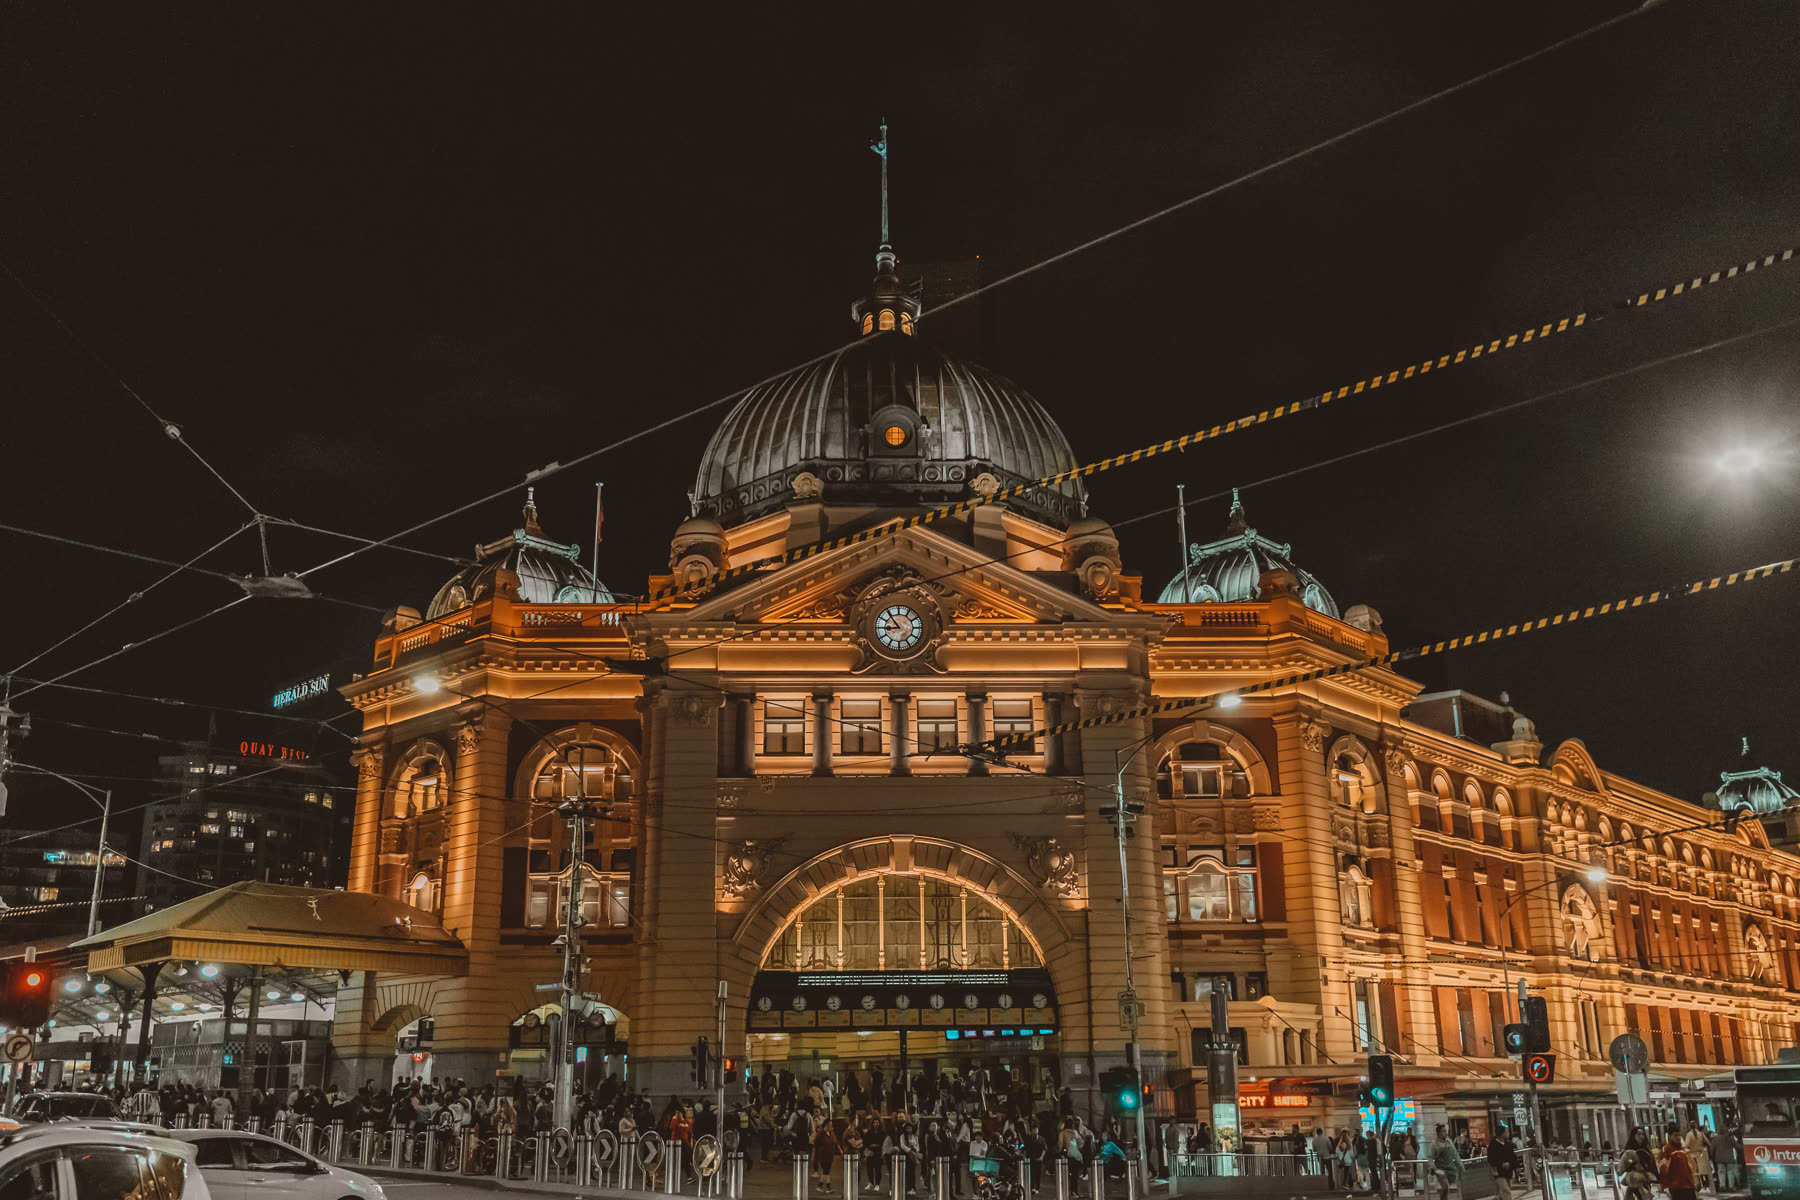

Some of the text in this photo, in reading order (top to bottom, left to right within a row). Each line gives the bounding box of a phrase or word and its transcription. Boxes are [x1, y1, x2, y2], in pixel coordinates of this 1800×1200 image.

[274, 677, 329, 707] HERALD SUN
[240, 741, 274, 756] QUAY
[1238, 1095, 1309, 1107] CITY HATTERS
